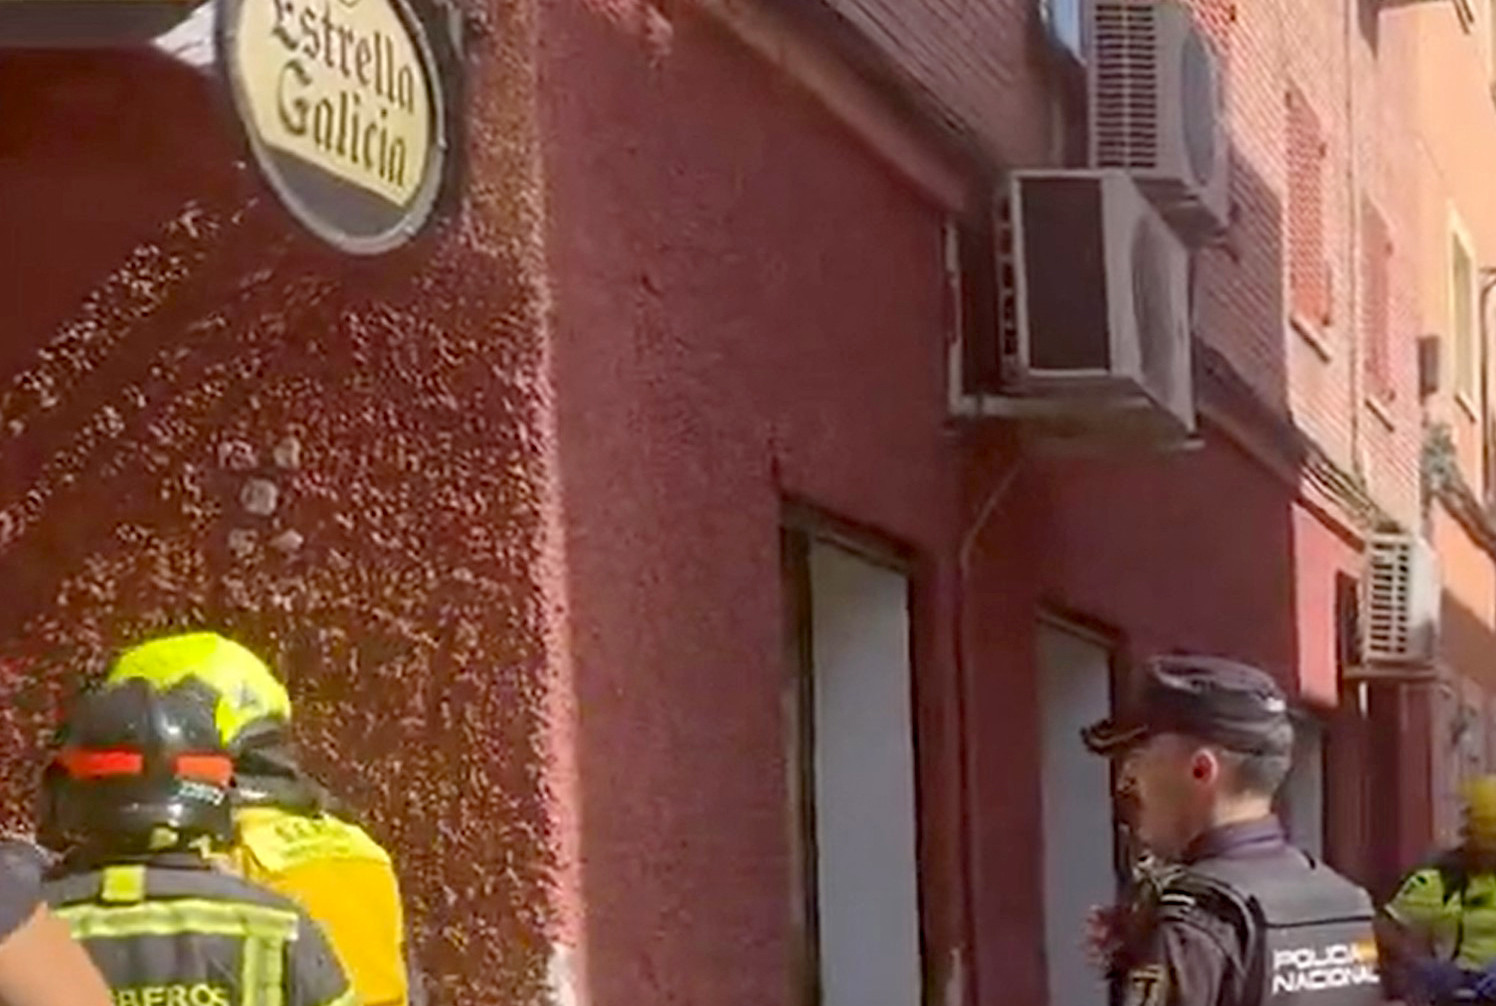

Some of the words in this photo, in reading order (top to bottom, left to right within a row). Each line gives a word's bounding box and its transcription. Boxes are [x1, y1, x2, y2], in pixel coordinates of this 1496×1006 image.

[271, 0, 415, 114] Estrella
[276, 59, 407, 187] Galicia
[1271, 966, 1380, 995] NACIONAL
